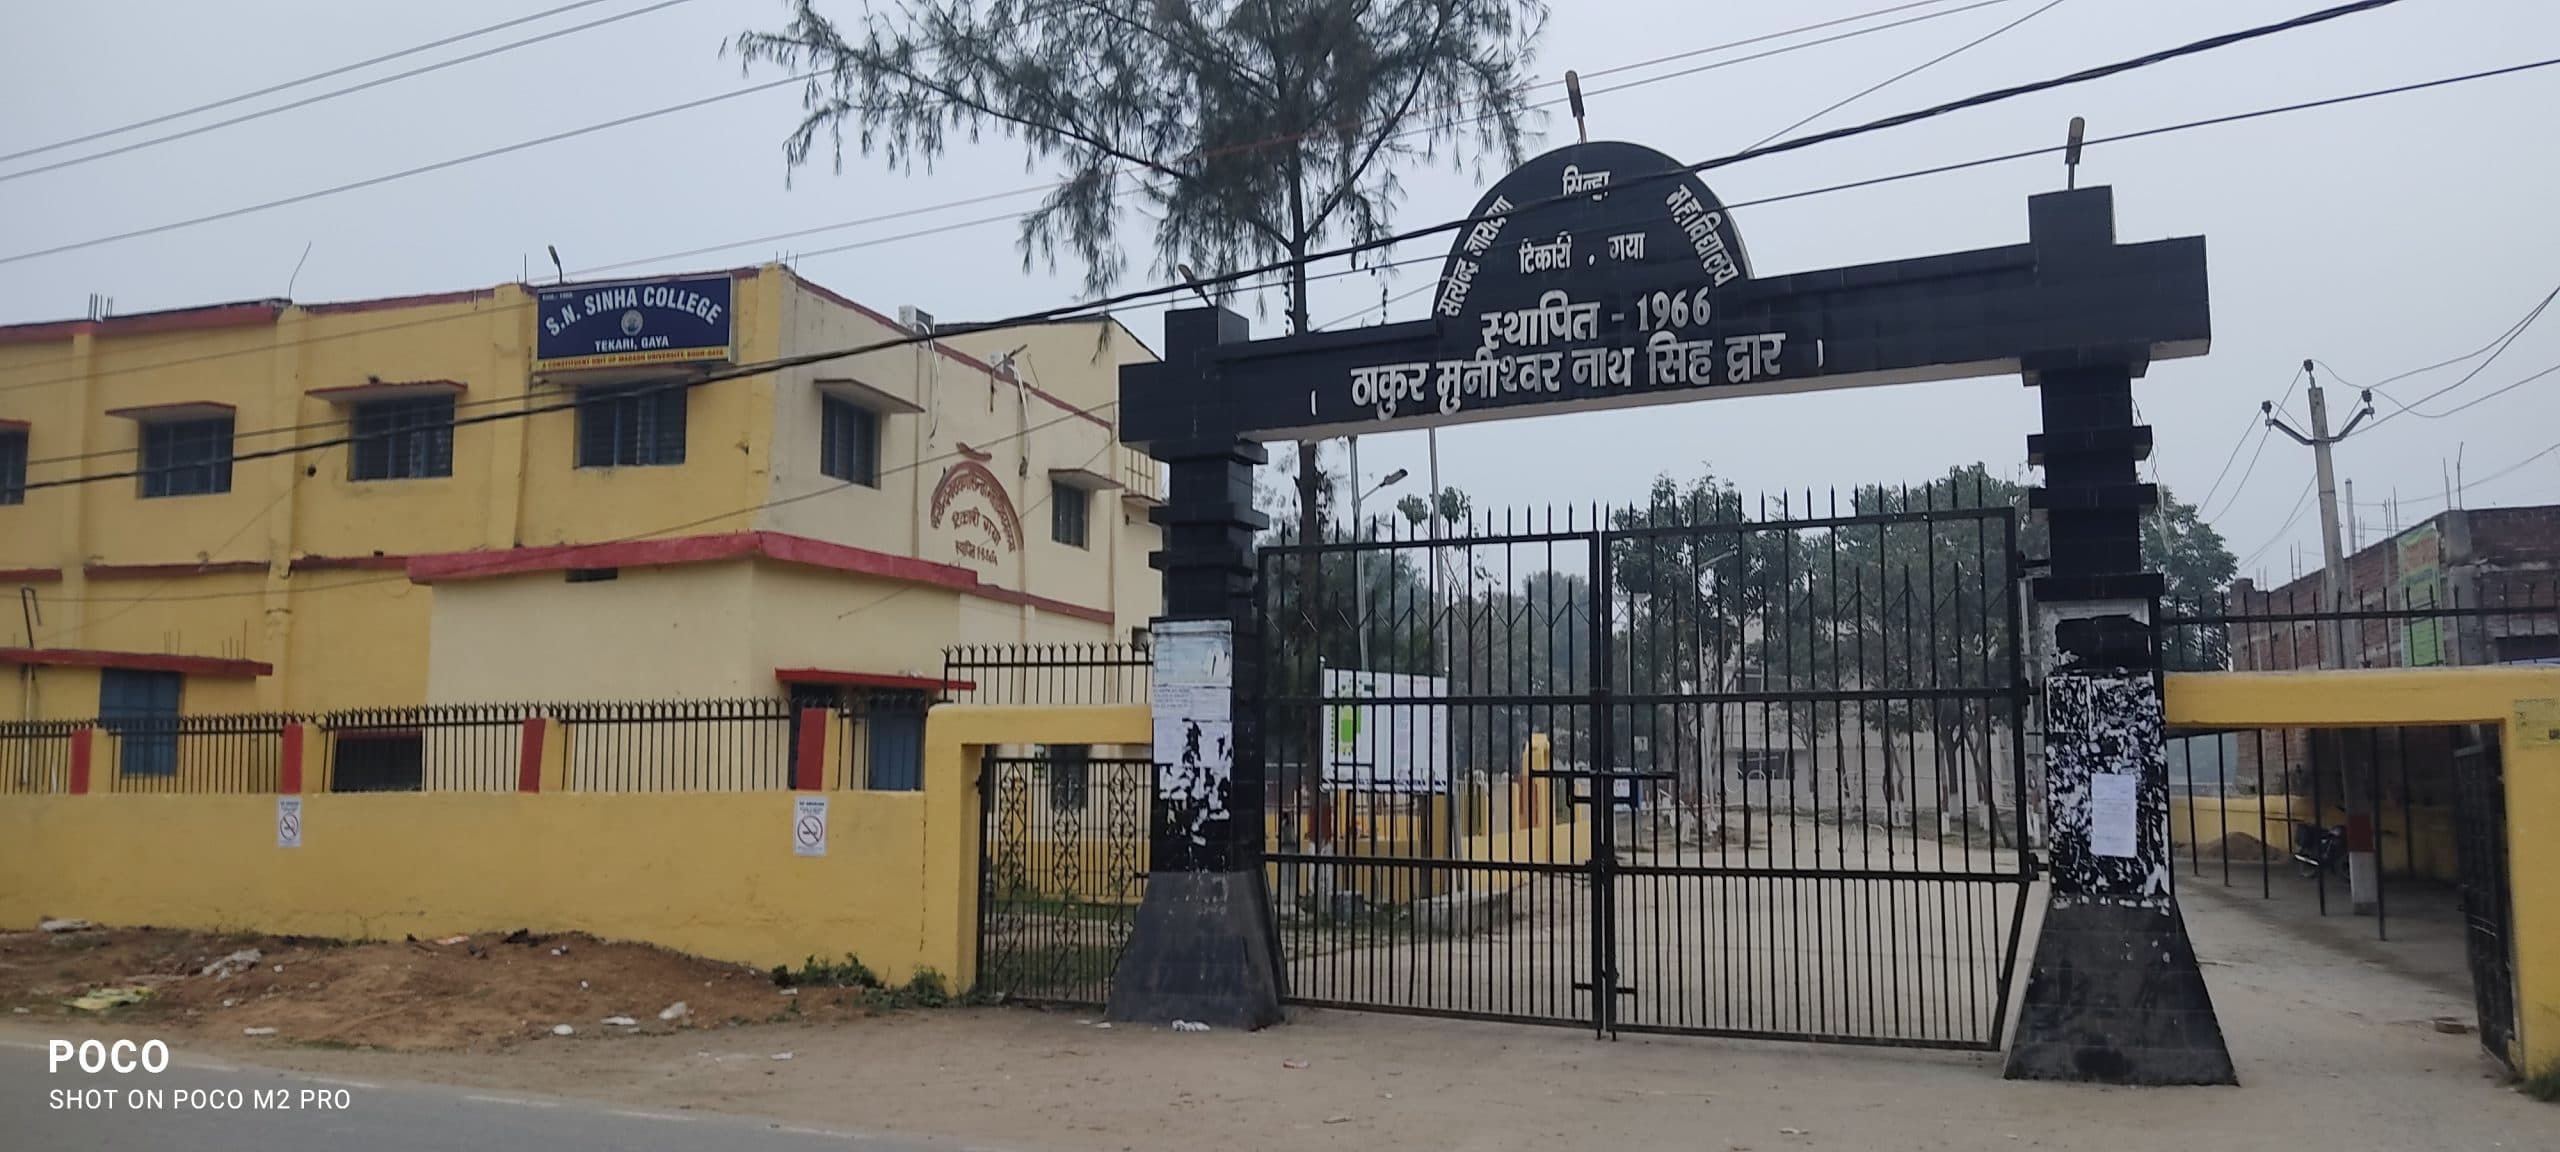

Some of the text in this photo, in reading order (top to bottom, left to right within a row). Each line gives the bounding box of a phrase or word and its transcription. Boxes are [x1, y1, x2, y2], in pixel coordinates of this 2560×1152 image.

[1607, 232, 1647, 262] गया
[1665, 184, 1739, 288] महाविद्यालय
[546, 286, 723, 337] S.N. SINHA COLLEGE
[1481, 290, 1601, 350] स्थापित
[1637, 286, 1712, 332] 1966
[595, 335, 669, 352] TEKARI, GAYA
[1350, 362, 1429, 421] ठाकुर
[1436, 346, 1566, 416] मुनीश्वर
[1571, 346, 1635, 388] नाथ
[1725, 332, 1787, 384] द्वार
